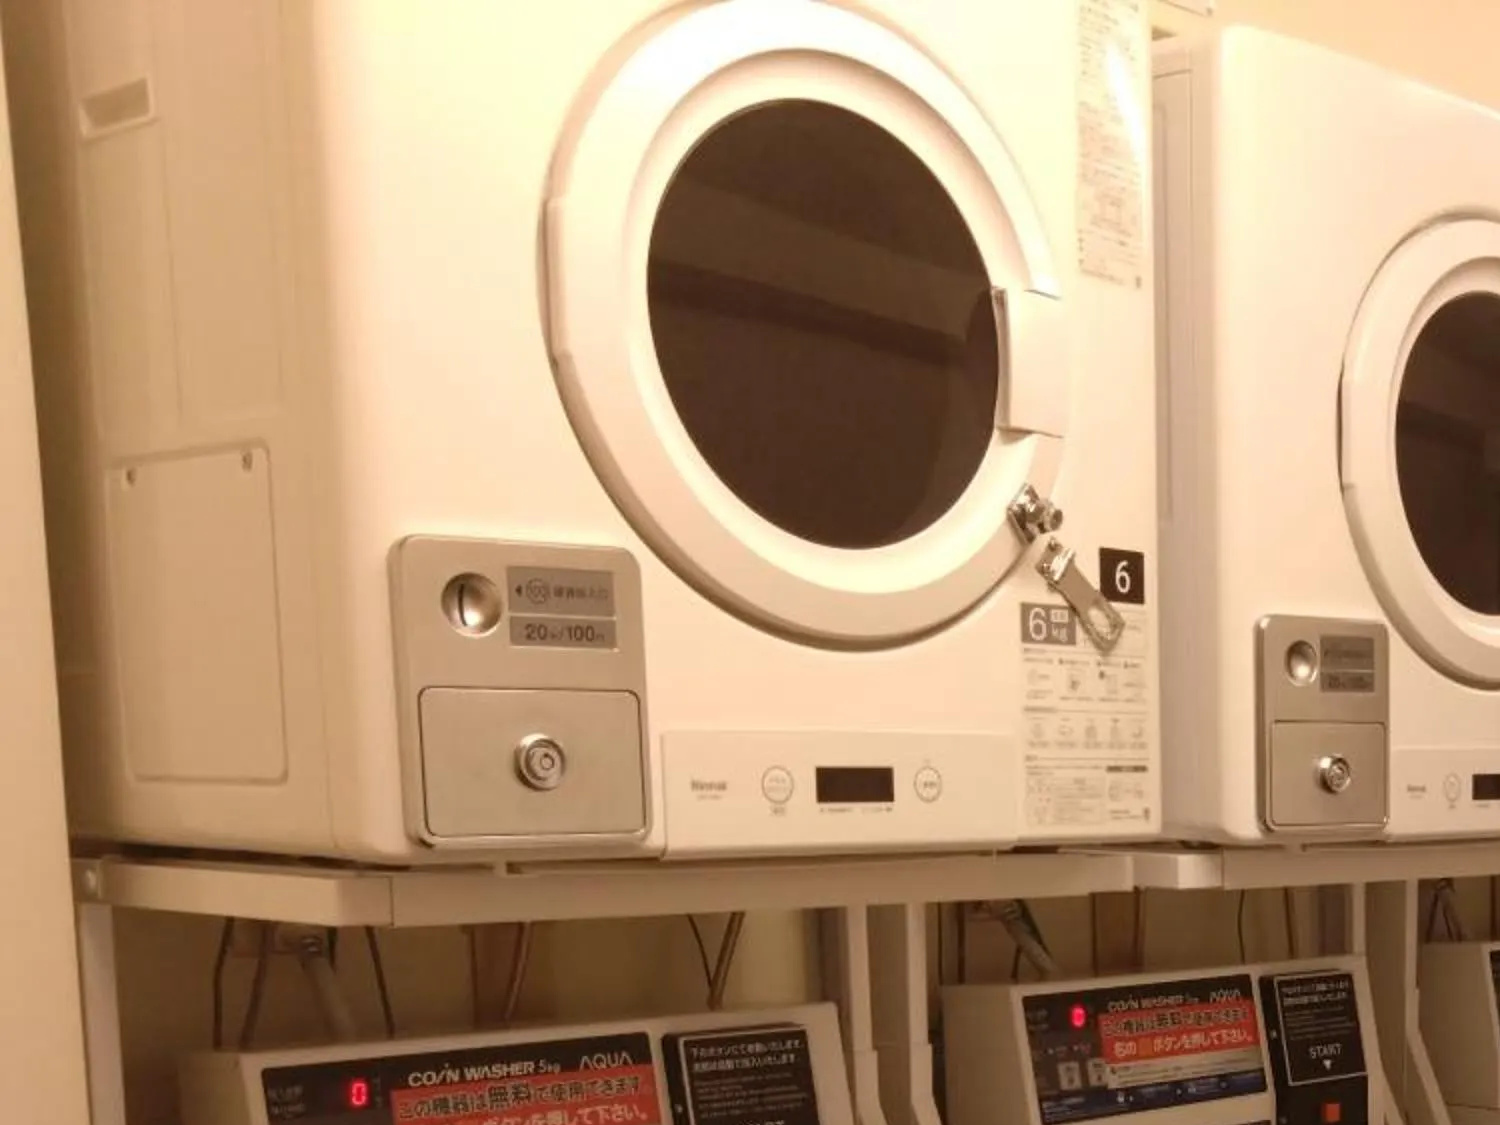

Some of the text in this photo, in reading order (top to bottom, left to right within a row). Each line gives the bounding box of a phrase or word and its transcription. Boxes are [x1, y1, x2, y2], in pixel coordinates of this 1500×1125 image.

[1114, 560, 1131, 594] 6
[1029, 607, 1047, 641] 6
[463, 1059, 535, 1082] WASHER
[578, 1050, 634, 1070] AQUA
[350, 1081, 369, 1106] 0
